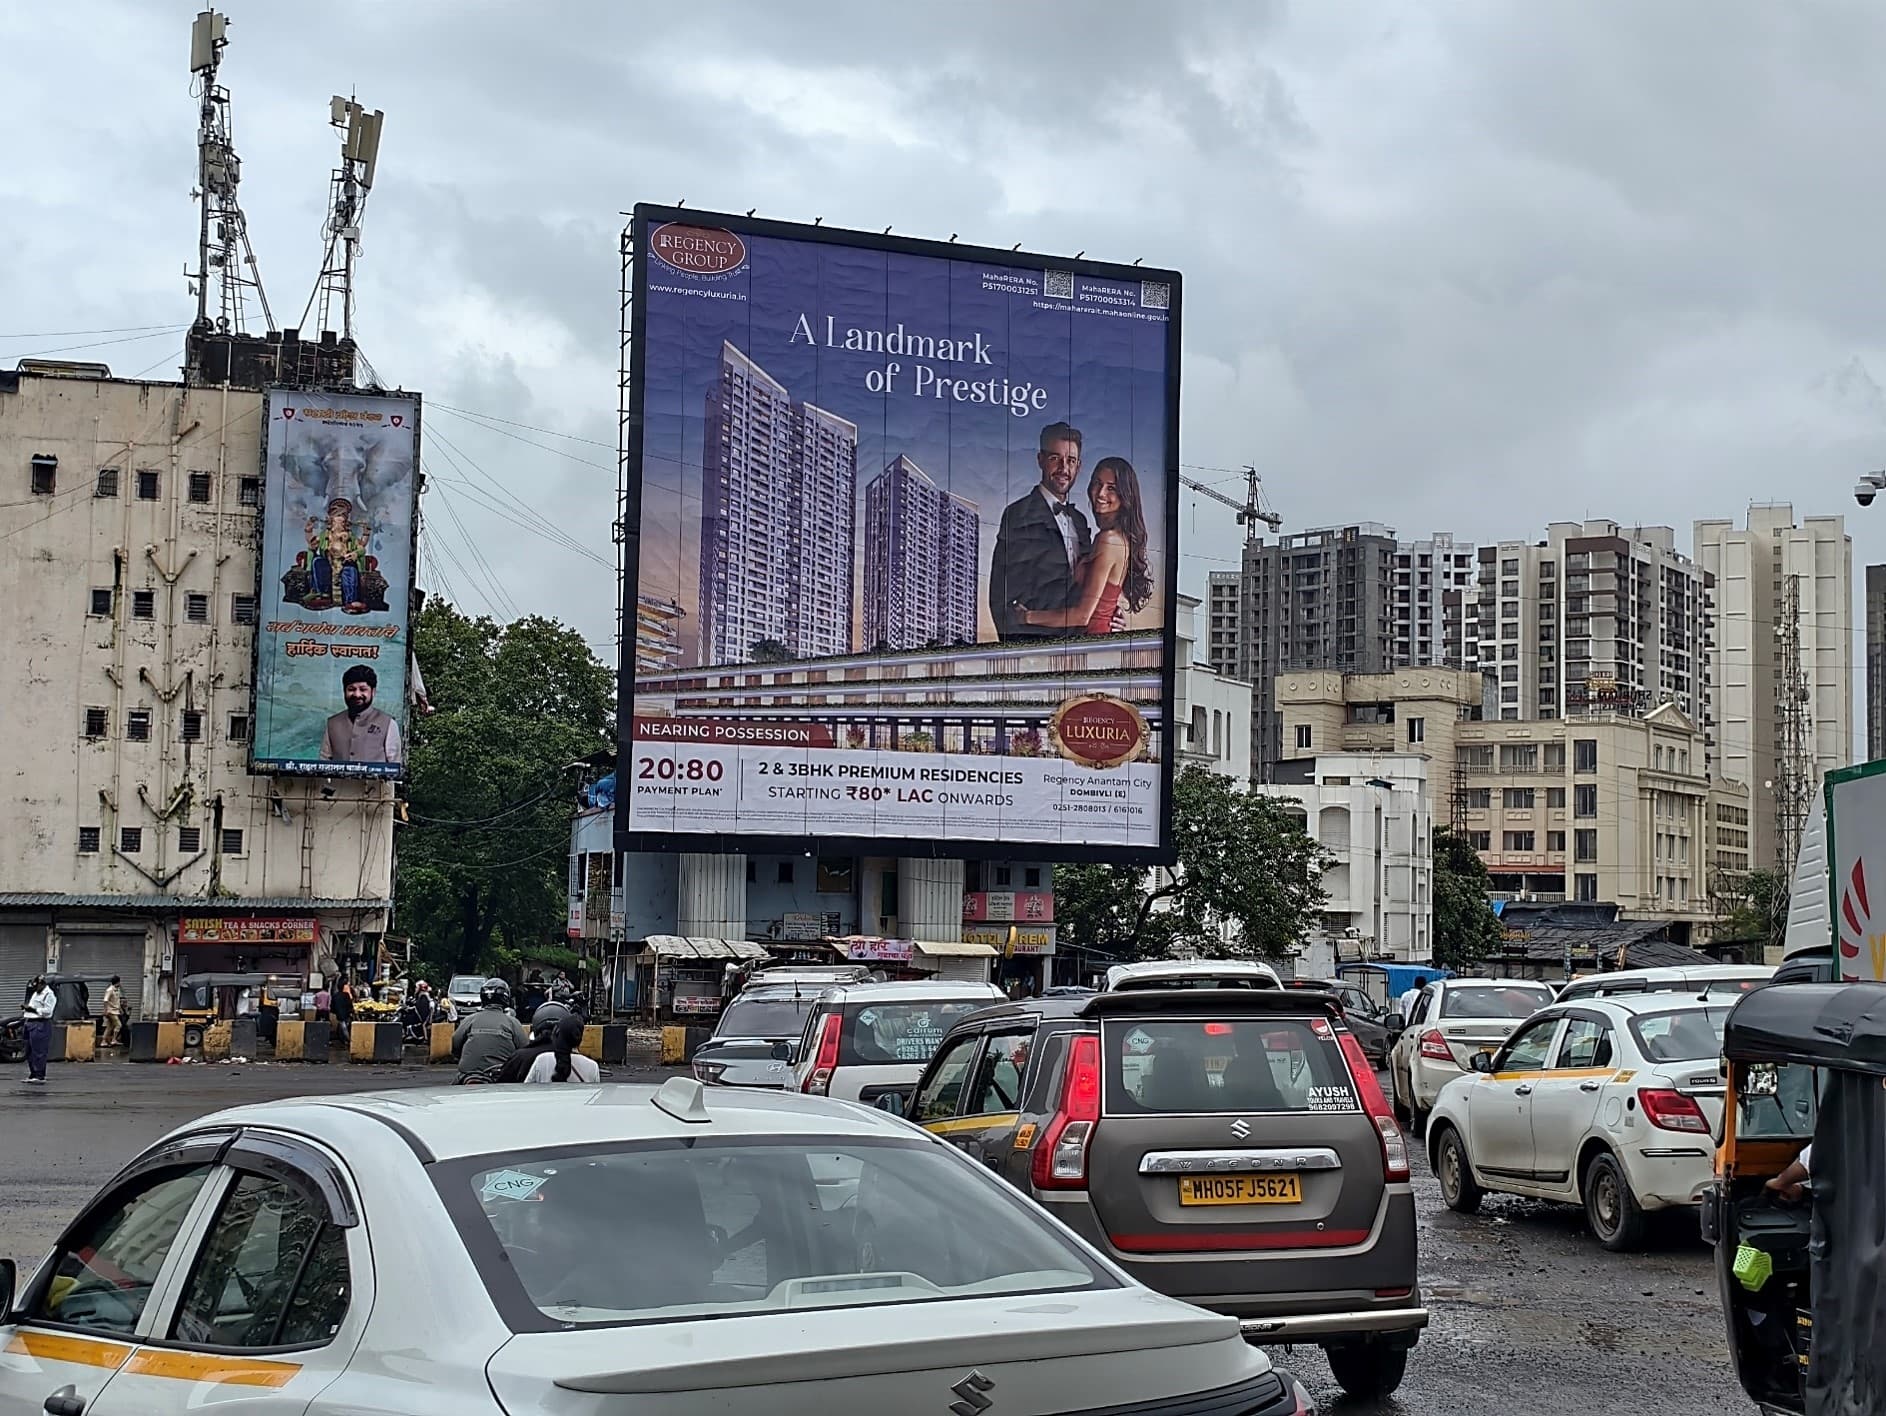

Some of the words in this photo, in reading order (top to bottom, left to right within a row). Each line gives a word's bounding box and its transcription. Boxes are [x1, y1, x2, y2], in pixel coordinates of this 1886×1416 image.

[660, 234, 736, 255] REGENCY
[672, 251, 728, 268] GROUP
[982, 273, 1024, 284] MahaRERA
[1026, 278, 1039, 286] No.
[649, 284, 747, 302] www.regencyluxuria.in
[1082, 285, 1122, 296] MahaRERA
[1123, 290, 1136, 298] No.
[788, 312, 816, 346] A
[826, 315, 993, 365] Landmark
[865, 362, 900, 393] of
[914, 365, 1048, 418] Prestige
[286, 639, 328, 656] हार्दिक
[331, 644, 380, 659] स्वागत!
[1083, 716, 1115, 724] REGENCY
[640, 723, 710, 737] NEARING
[715, 726, 810, 742] POSSESSION
[1066, 724, 1130, 741] LUXURIA
[638, 757, 724, 782] 20:80
[758, 762, 768, 775] 2
[773, 763, 784, 776] &
[788, 763, 834, 778] 3BHK
[838, 765, 915, 780] PREMIUM
[920, 768, 1024, 784] RESIDENCIES
[1043, 774, 1086, 786] Regency
[1086, 776, 1130, 788] Anantam
[1133, 778, 1152, 790] City
[638, 786, 688, 796] PAYMENT
[768, 786, 840, 800] STARTING
[897, 788, 934, 804] LAC
[938, 792, 1014, 806] ONWARDS
[1070, 788, 1112, 798] DOMBIVLI
[184, 918, 222, 930] SATISH
[224, 921, 238, 929] TEA
[282, 920, 314, 929] CORNER
[1308, 1086, 1349, 1096] AYUSH
[1307, 1096, 1322, 1104] TOURS
[1324, 1096, 1333, 1104] AND
[1334, 1096, 1354, 1104] TRAVELS
[494, 1177, 534, 1191] CNG
